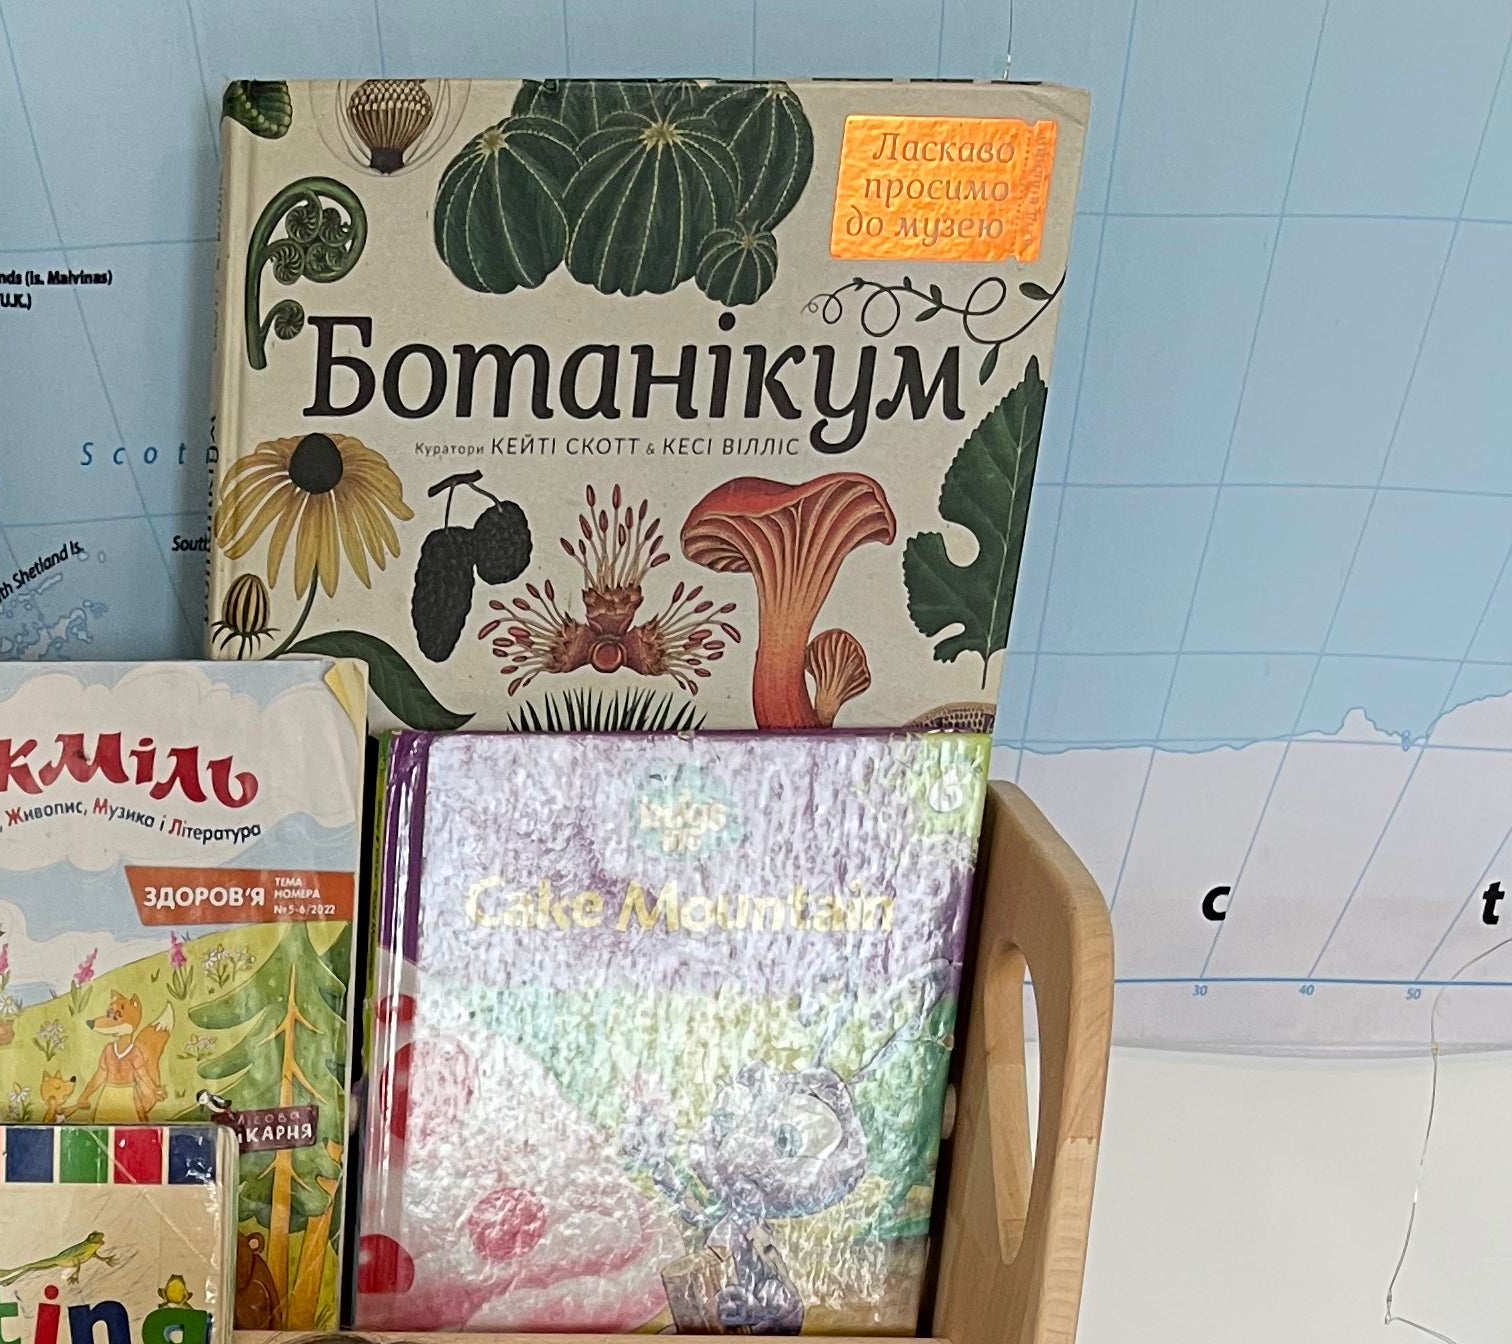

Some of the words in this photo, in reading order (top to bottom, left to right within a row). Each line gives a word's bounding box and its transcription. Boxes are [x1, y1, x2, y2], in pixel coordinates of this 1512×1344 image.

[872, 132, 1016, 164] Ласкаво
[864, 178, 1010, 208] просимо
[845, 204, 884, 237] до
[894, 214, 1004, 248] музею
[47, 269, 113, 286] Malvinas)
[303, 311, 966, 455] Ботанікум
[80, 442, 186, 466] Scot
[414, 442, 485, 457] Куратори
[491, 434, 556, 456] КЕЙТІ
[565, 437, 640, 456] СКОТТ
[645, 443, 655, 456] &
[662, 437, 713, 456] КЕСІ
[721, 437, 800, 456] ВІЛЛІС
[12, 544, 69, 590] Shetland
[4, 798, 88, 828] Живопис,
[91, 796, 156, 829] Музика
[159, 813, 167, 831] і
[168, 817, 262, 846] Література
[274, 876, 303, 888] ТЕМА
[274, 888, 321, 900] НОМЕРА
[465, 875, 605, 932] Cake
[616, 878, 896, 932] Mountain
[1192, 985, 1208, 997] 30
[1298, 985, 1315, 996] 40
[1405, 988, 1422, 1000] 50
